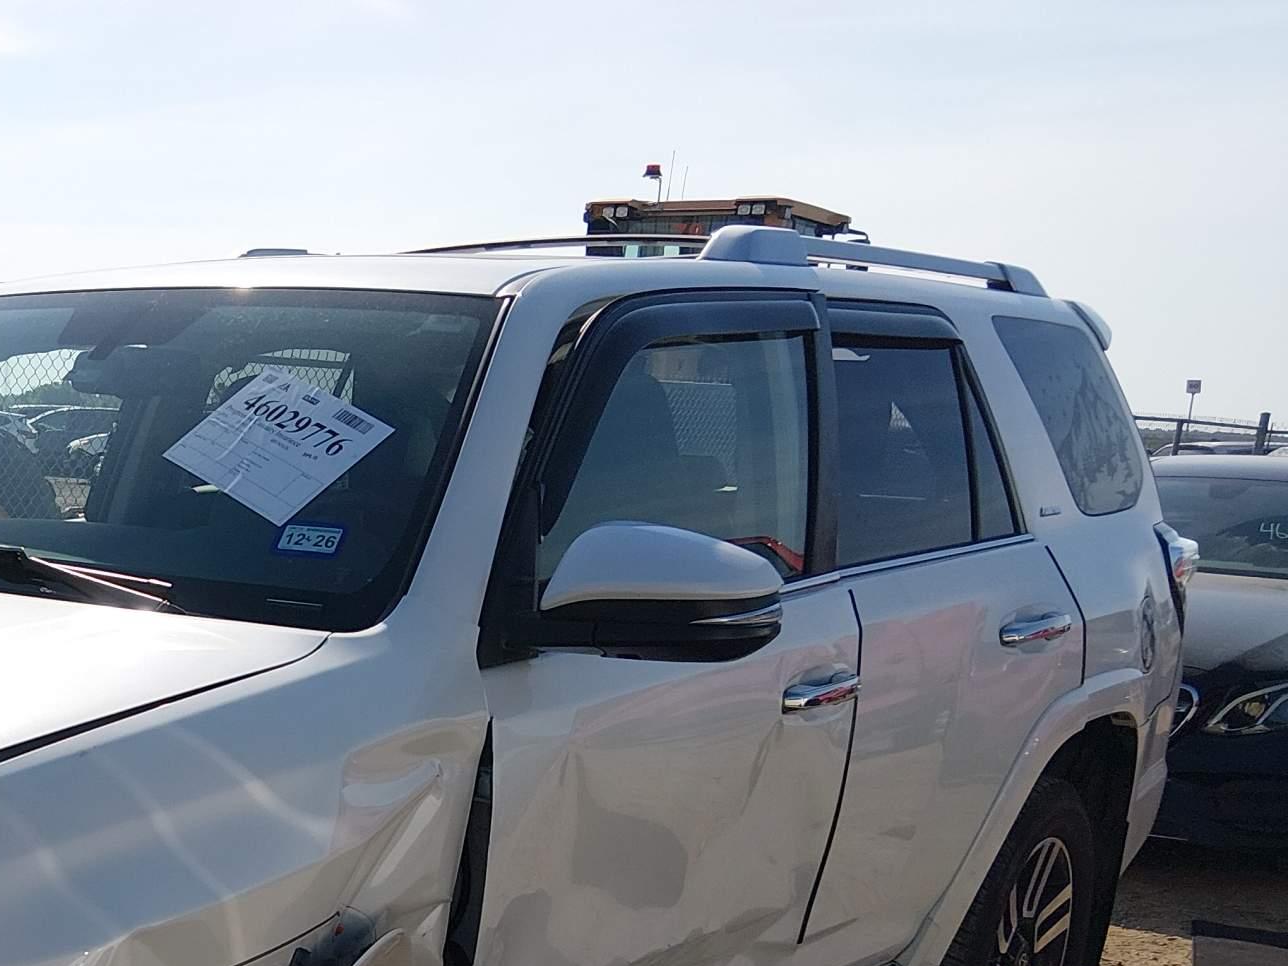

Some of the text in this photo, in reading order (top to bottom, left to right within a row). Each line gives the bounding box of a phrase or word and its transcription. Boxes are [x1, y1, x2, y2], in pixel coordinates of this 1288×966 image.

[243, 394, 353, 456] 46029776
[286, 532, 337, 549] 12 26
